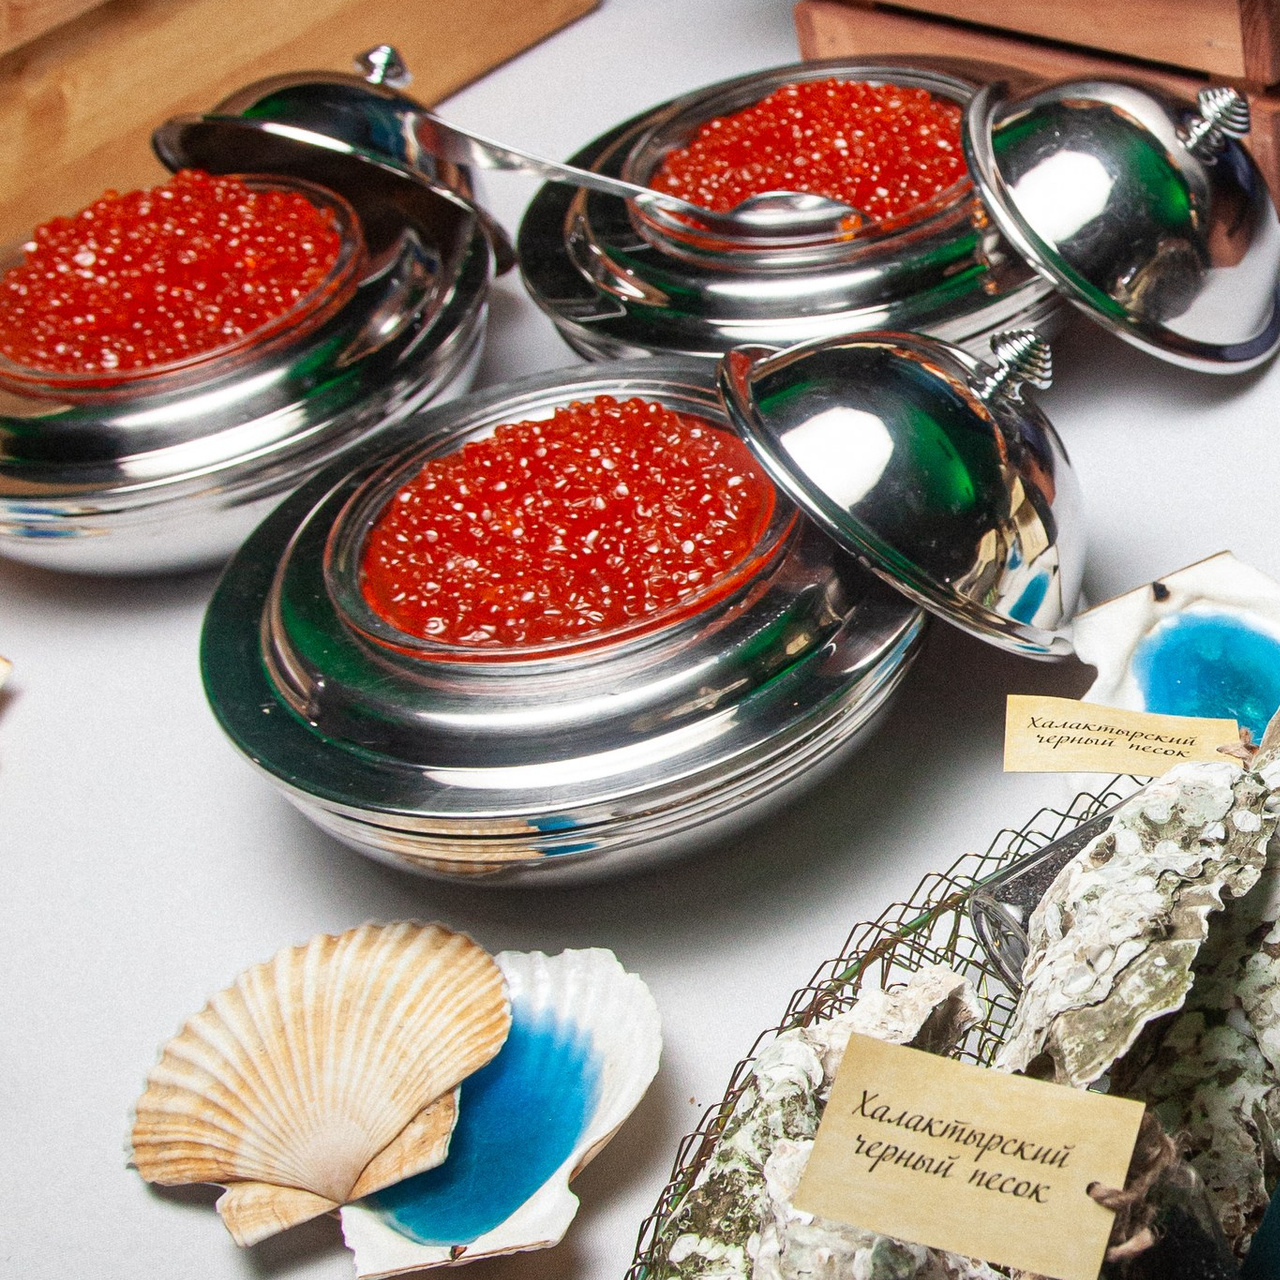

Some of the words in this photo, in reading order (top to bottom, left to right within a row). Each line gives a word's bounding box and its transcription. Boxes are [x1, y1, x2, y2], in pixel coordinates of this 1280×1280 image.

[1027, 716, 1198, 747] Халактырский
[1036, 733, 1117, 749] черный
[1129, 742, 1192, 758] песок
[851, 1089, 1076, 1169] Халактырский
[854, 1133, 961, 1179] черный
[967, 1169, 1051, 1204] песок
